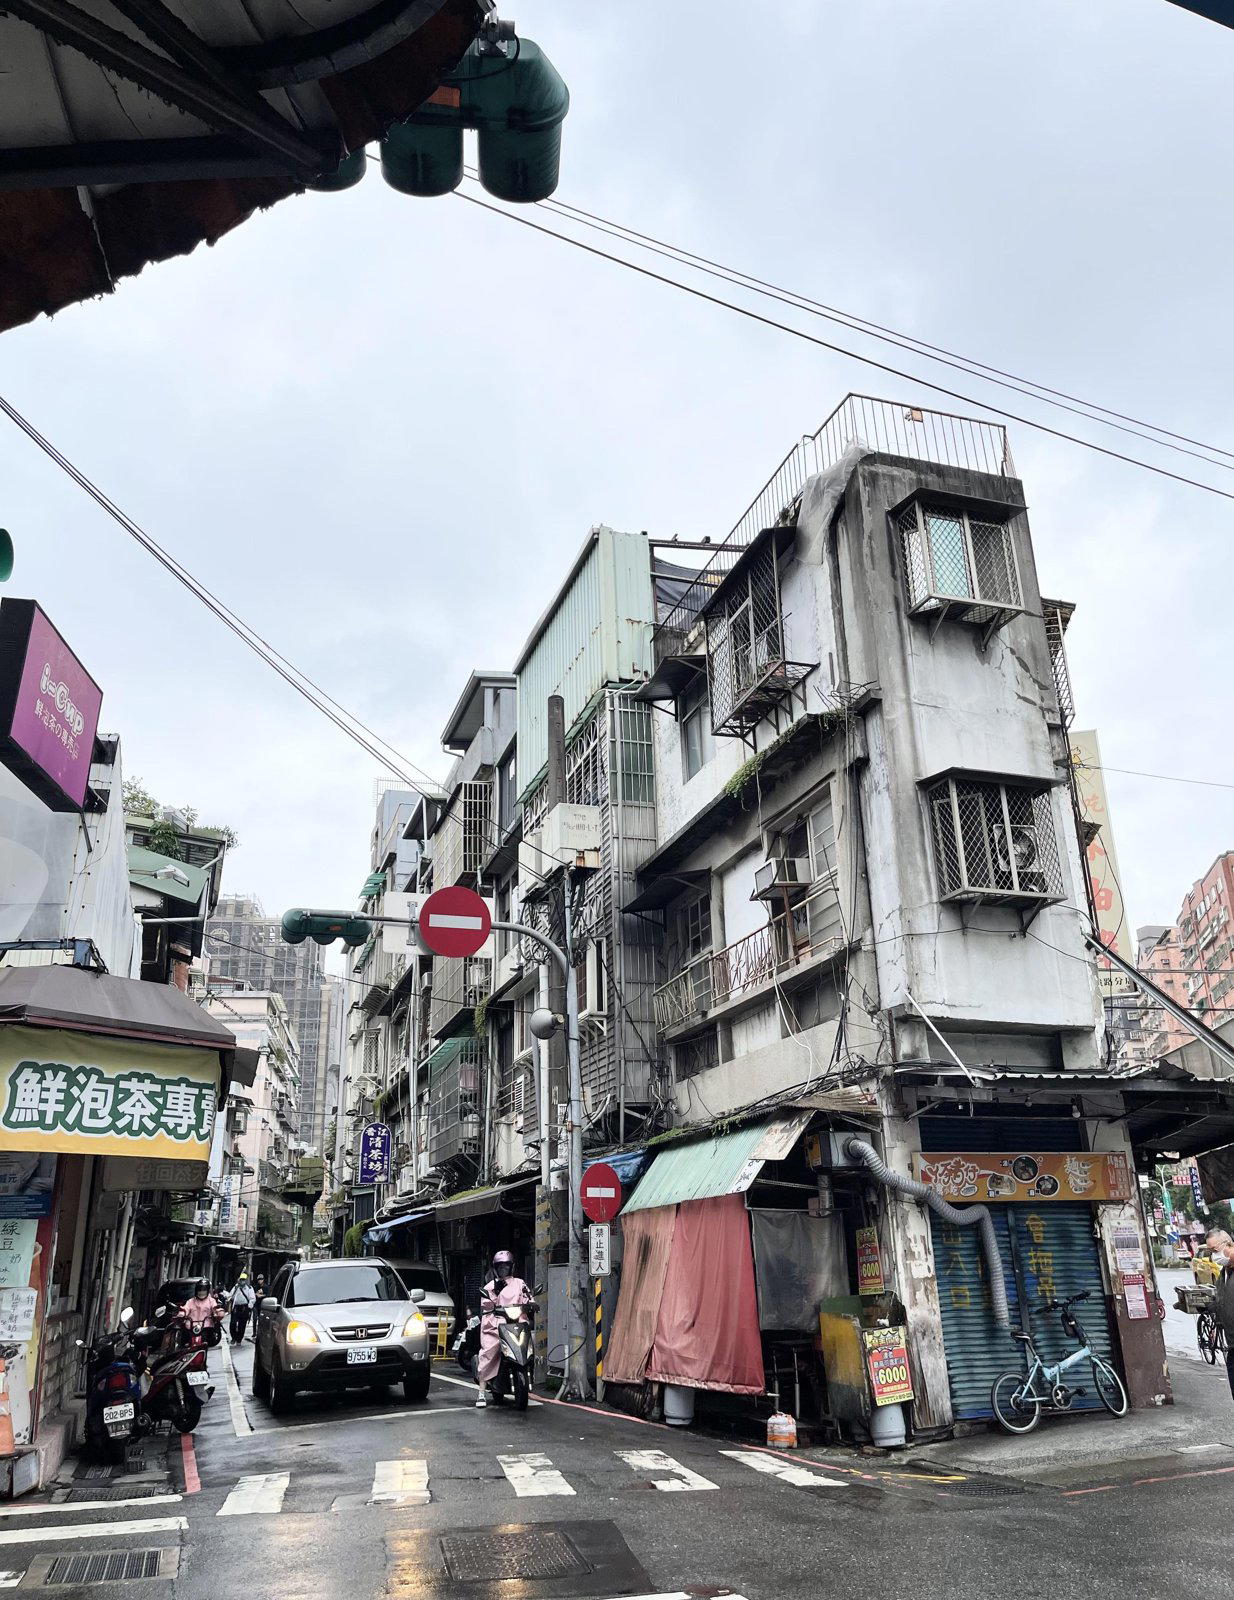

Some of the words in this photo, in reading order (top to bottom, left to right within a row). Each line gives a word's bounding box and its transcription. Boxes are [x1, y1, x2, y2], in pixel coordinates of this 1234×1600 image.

[594, 1228, 605, 1271] 禁止進入
[878, 1365, 907, 1385] 6000
[104, 1408, 133, 1421] 202-BPS
